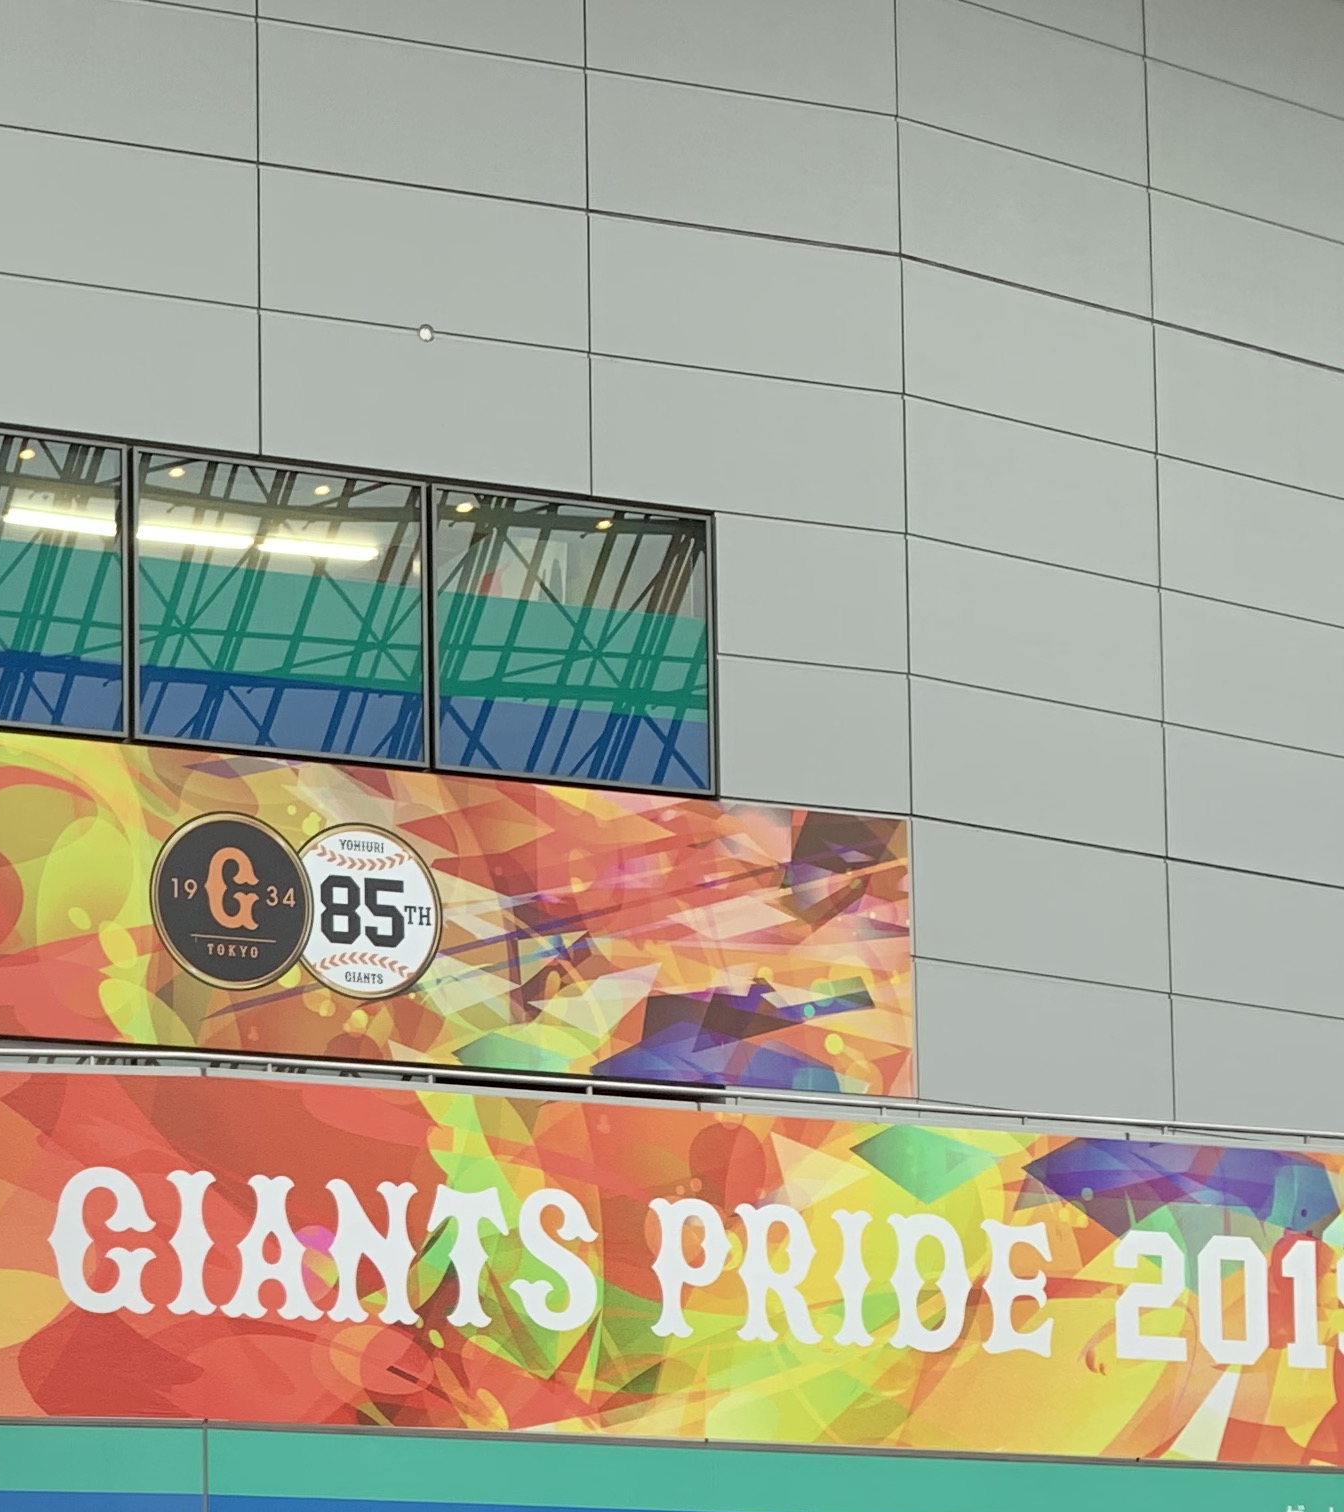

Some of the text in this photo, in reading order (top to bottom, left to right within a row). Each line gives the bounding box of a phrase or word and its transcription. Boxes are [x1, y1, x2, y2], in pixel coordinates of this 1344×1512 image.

[339, 838, 384, 854] YOMIURI
[171, 846, 296, 931] 19 G 34
[207, 943, 259, 958] TOKYO
[345, 971, 383, 985] GIANTS
[47, 1166, 1344, 1369] GIANTS PRIDE 201
